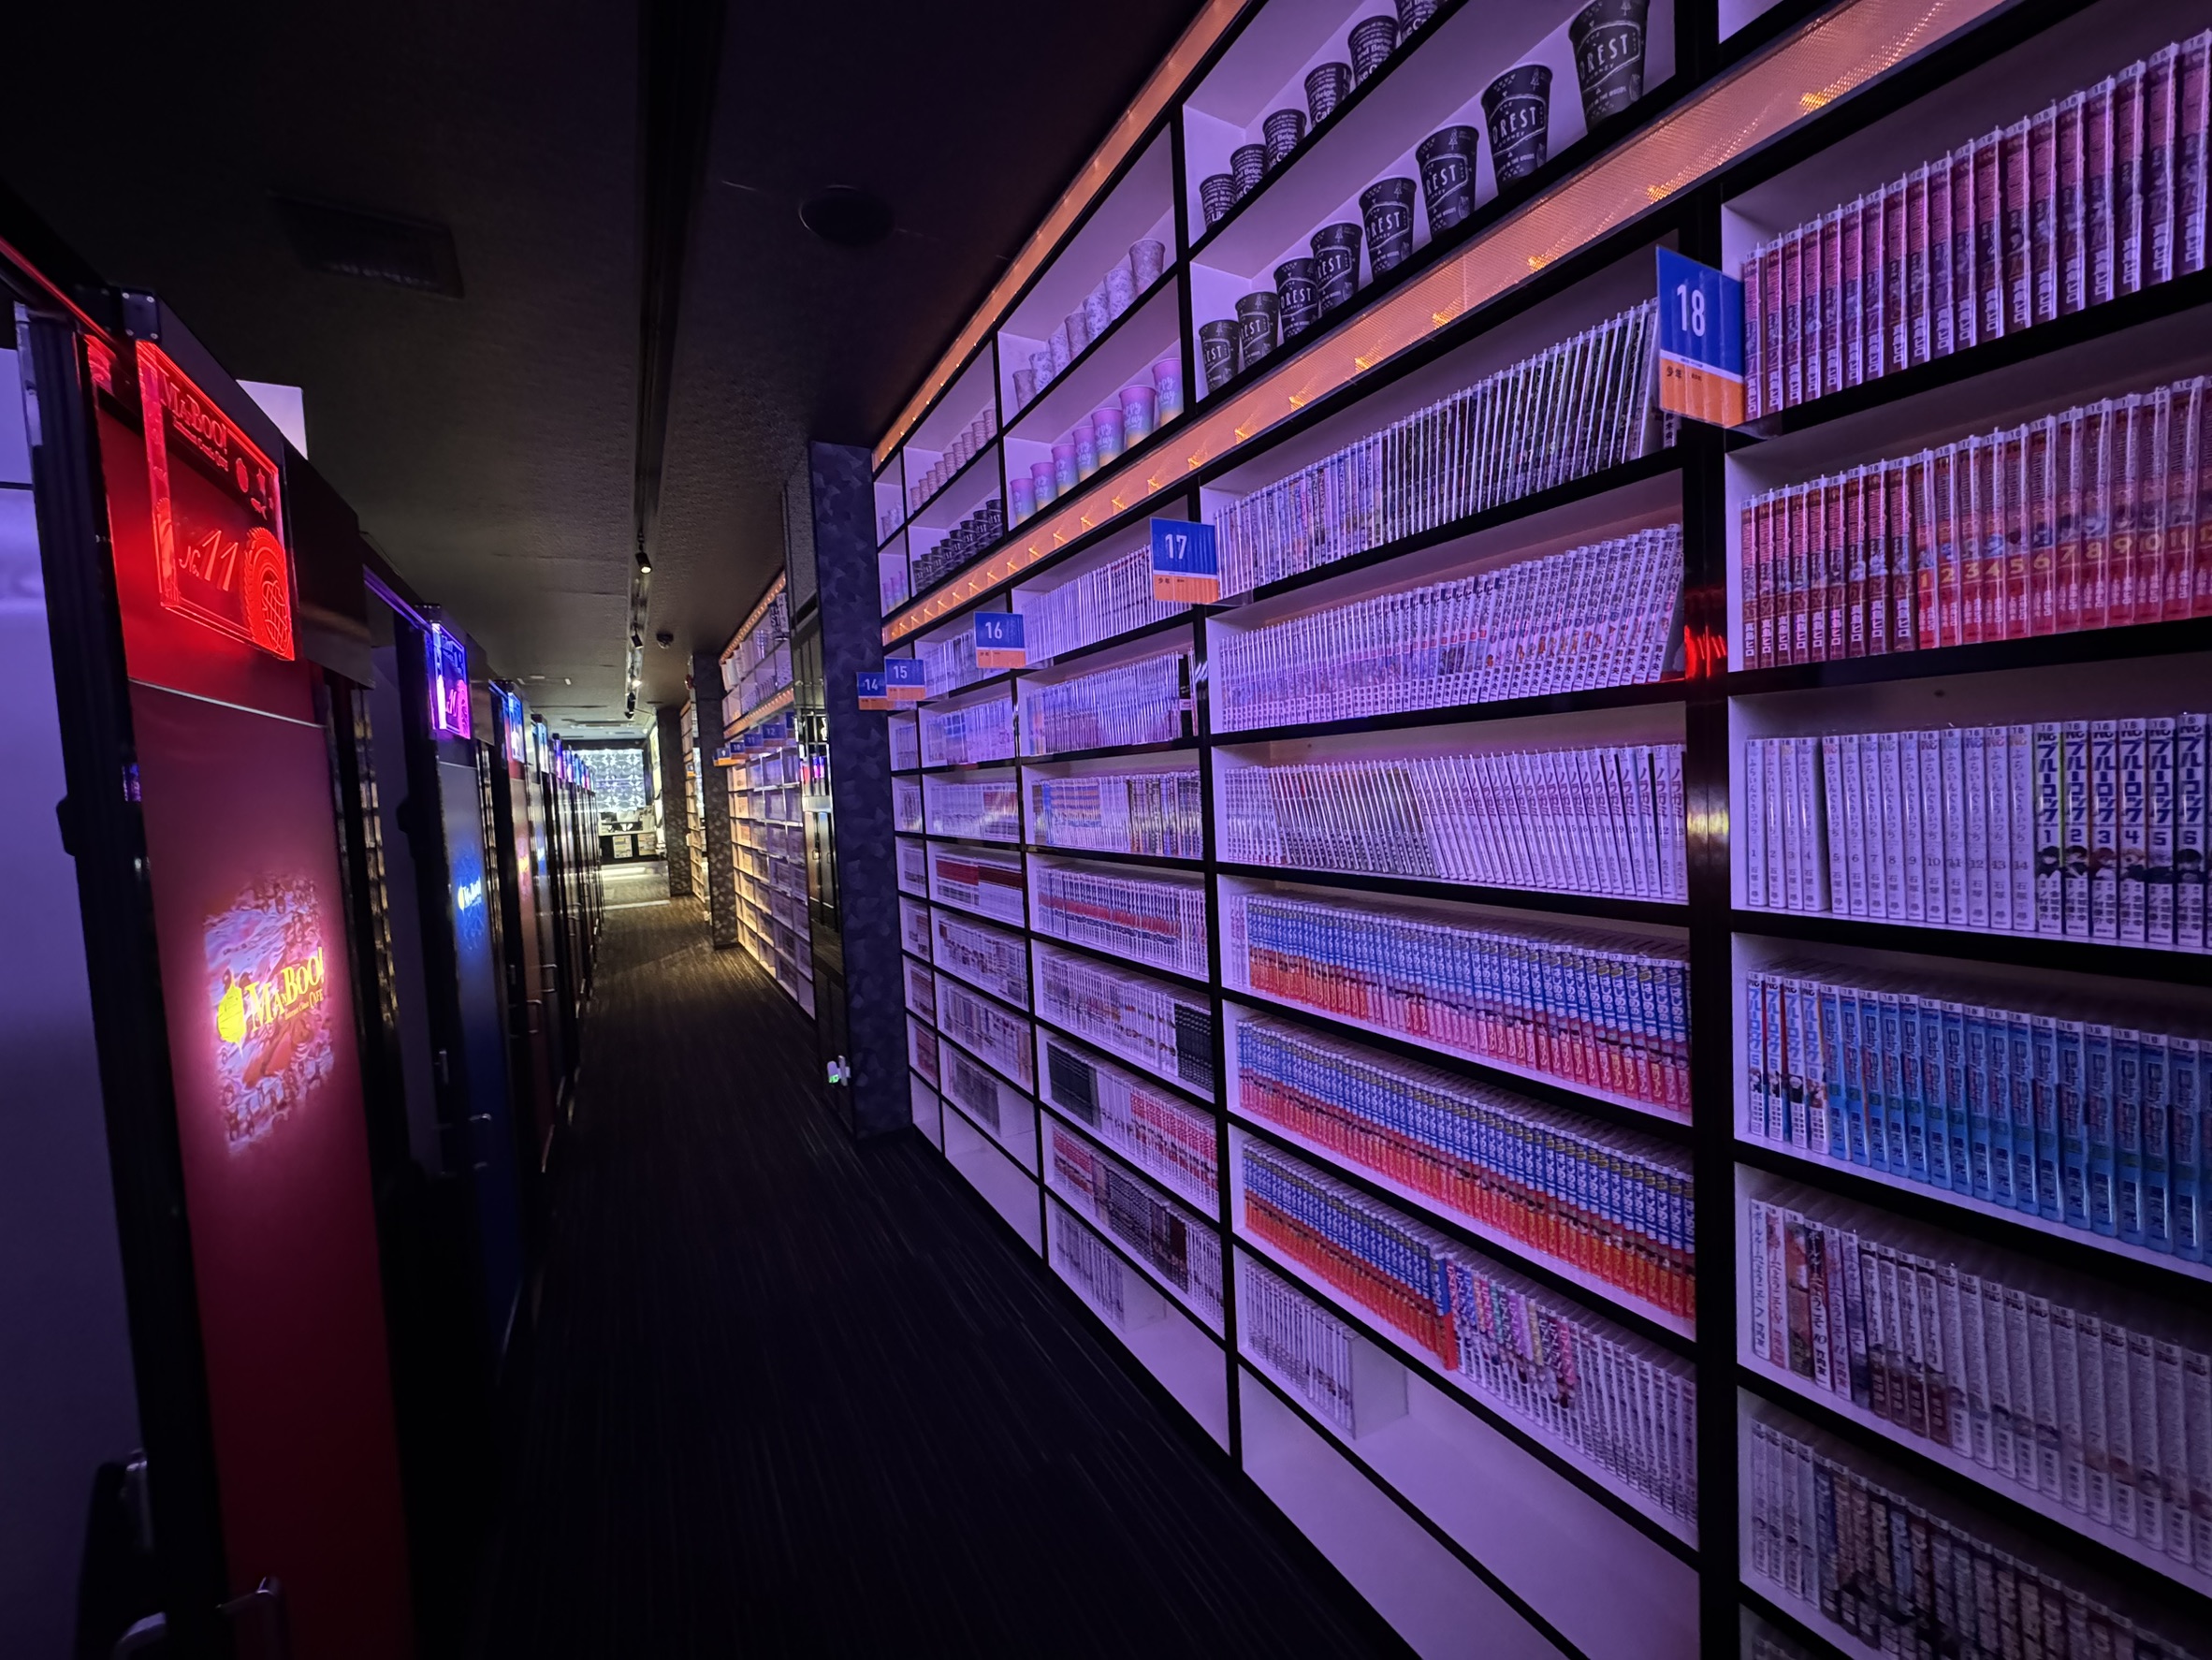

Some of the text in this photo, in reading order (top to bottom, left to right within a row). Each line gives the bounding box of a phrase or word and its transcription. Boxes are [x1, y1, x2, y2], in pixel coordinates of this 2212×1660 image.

[1316, 107, 1333, 123] Caf
[1677, 284, 1706, 337] 18
[1666, 365, 1681, 379] 少年
[1165, 533, 1187, 560] 17
[2114, 537, 2132, 553] 9
[2139, 533, 2161, 552] 10
[2170, 530, 2188, 547] 11
[2061, 545, 2077, 561] 7
[2086, 542, 2103, 559] 8
[202, 530, 239, 592] 11
[1986, 562, 2001, 576] 4
[2010, 558, 2025, 574] 5
[2033, 553, 2051, 569] 6
[1941, 568, 1955, 583] 2
[1966, 562, 1980, 578] 3
[1920, 573, 1928, 587] 1
[985, 622, 1003, 639] 16
[893, 665, 908, 679] 15
[864, 678, 879, 691] 14
[2037, 742, 2058, 843] ブルーロック 1
[2065, 739, 2086, 842] ブルーロック 2
[2094, 737, 2117, 843] ブルーロック 3
[2121, 736, 2145, 843] ブルーロック 4
[2149, 736, 2173, 845] ブルーロック 5
[2179, 735, 2204, 844] ブルーロック 6
[1769, 850, 1776, 858] 2
[1788, 851, 1795, 859] 3
[1804, 851, 1812, 860] 4
[1852, 853, 1859, 862] 6
[1871, 854, 1878, 863] 7
[1888, 855, 1896, 865] 8
[1909, 855, 1916, 865] 9
[1928, 857, 1941, 866] 10
[1947, 858, 1962, 868] 11
[1970, 859, 1984, 869] 12
[1992, 860, 2006, 870] 13
[2015, 860, 2029, 870] 14
